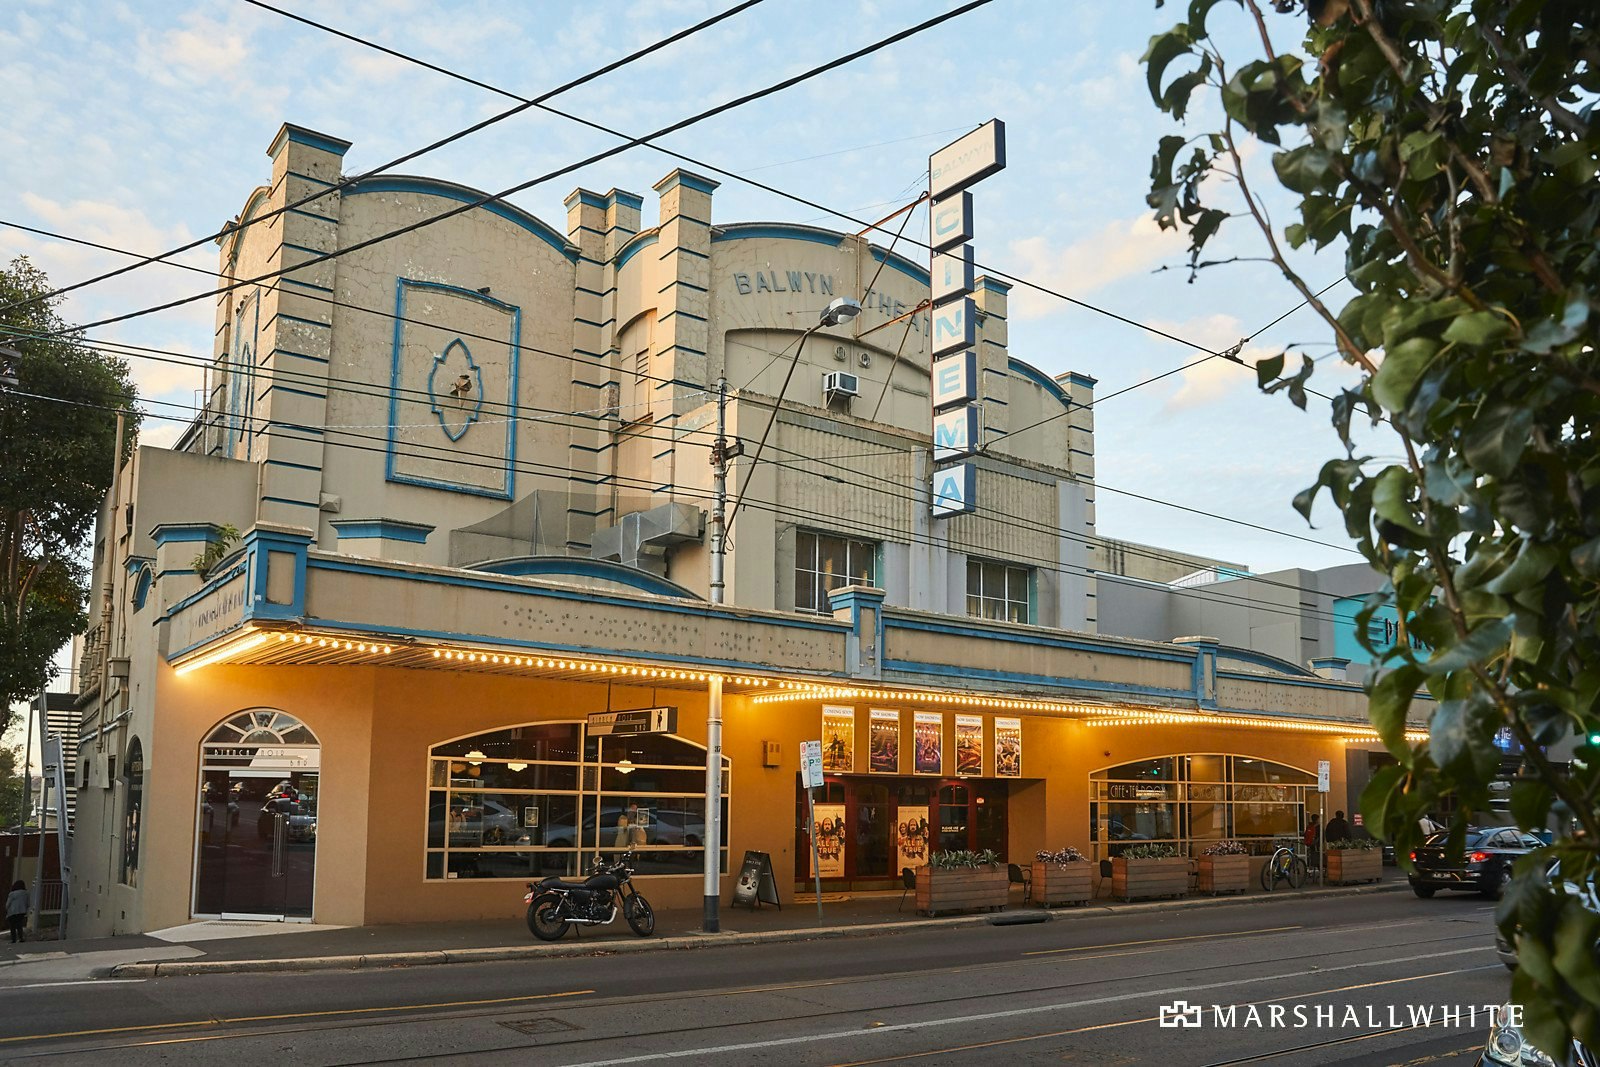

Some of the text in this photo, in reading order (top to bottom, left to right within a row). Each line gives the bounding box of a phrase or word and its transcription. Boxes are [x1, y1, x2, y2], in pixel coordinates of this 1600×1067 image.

[932, 141, 993, 180] BALWYN
[734, 271, 834, 296] BALWYN
[935, 209, 966, 506] CINEMA
[1110, 784, 1125, 798] CAFE
